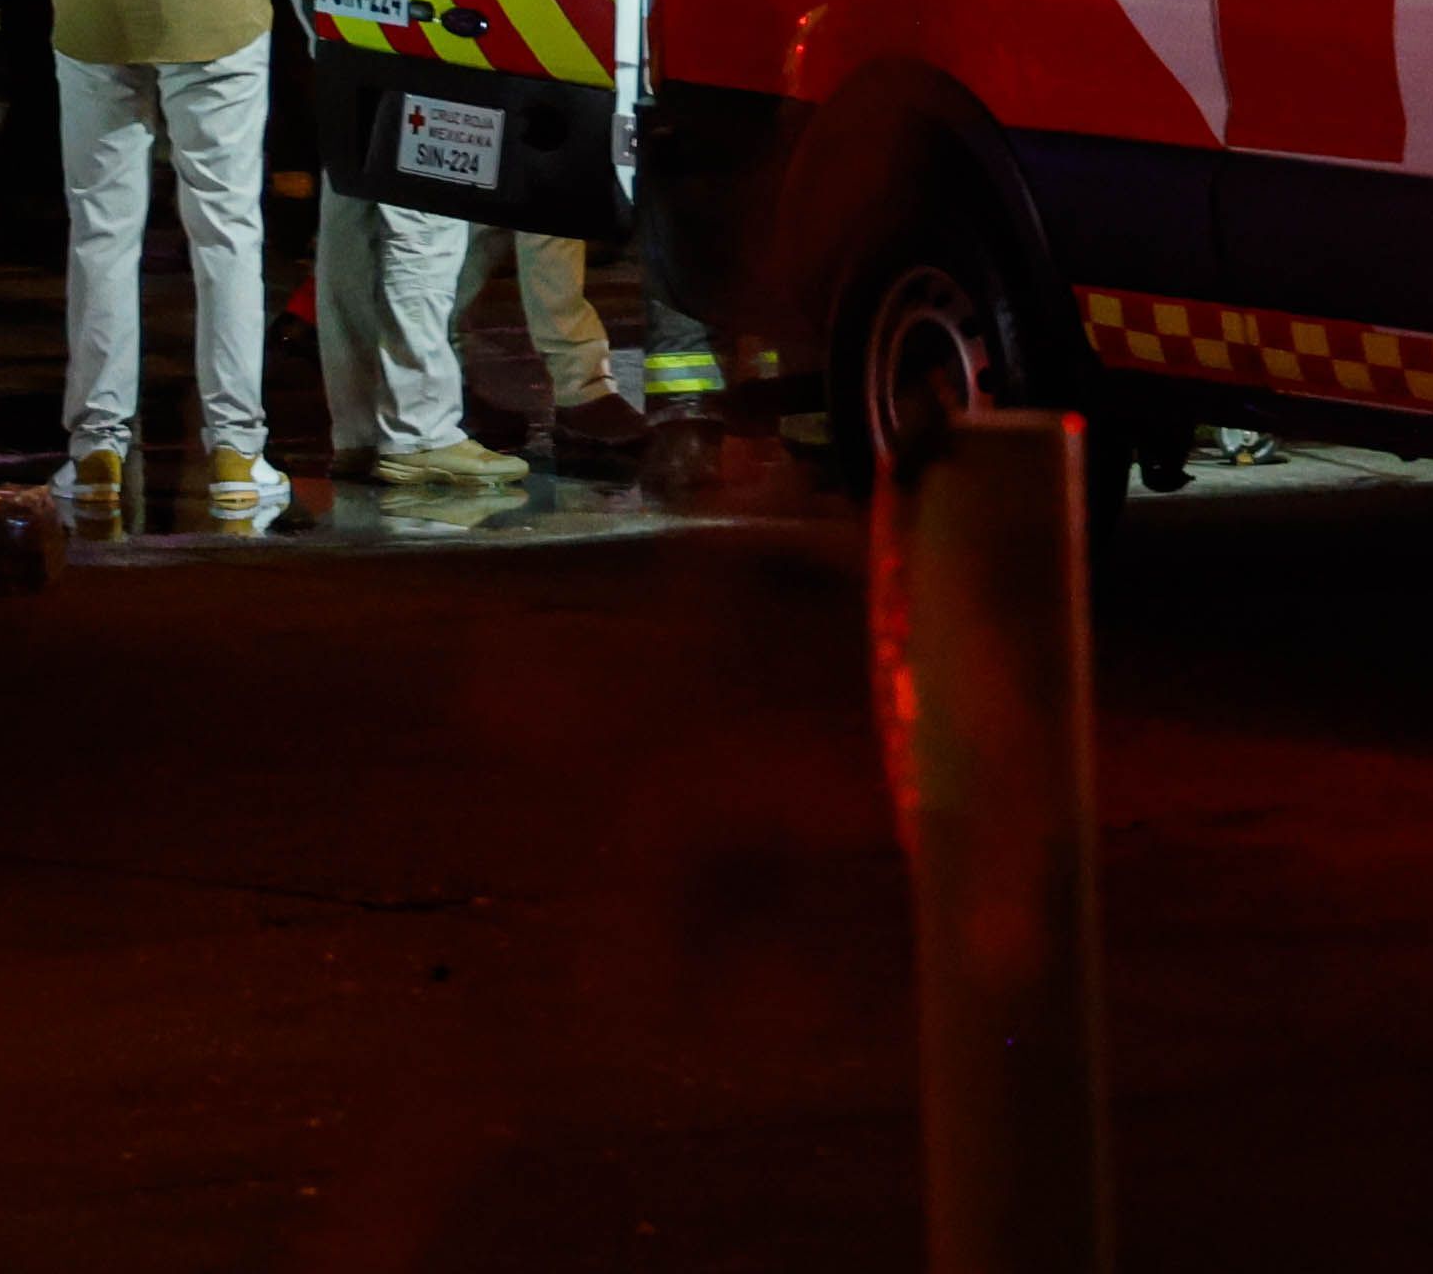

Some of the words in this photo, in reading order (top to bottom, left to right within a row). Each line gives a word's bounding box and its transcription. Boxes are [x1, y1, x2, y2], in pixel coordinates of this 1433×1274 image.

[429, 107, 461, 125] CRUZ
[428, 126, 493, 148] MEXICANA
[416, 142, 480, 175] SIN-224
